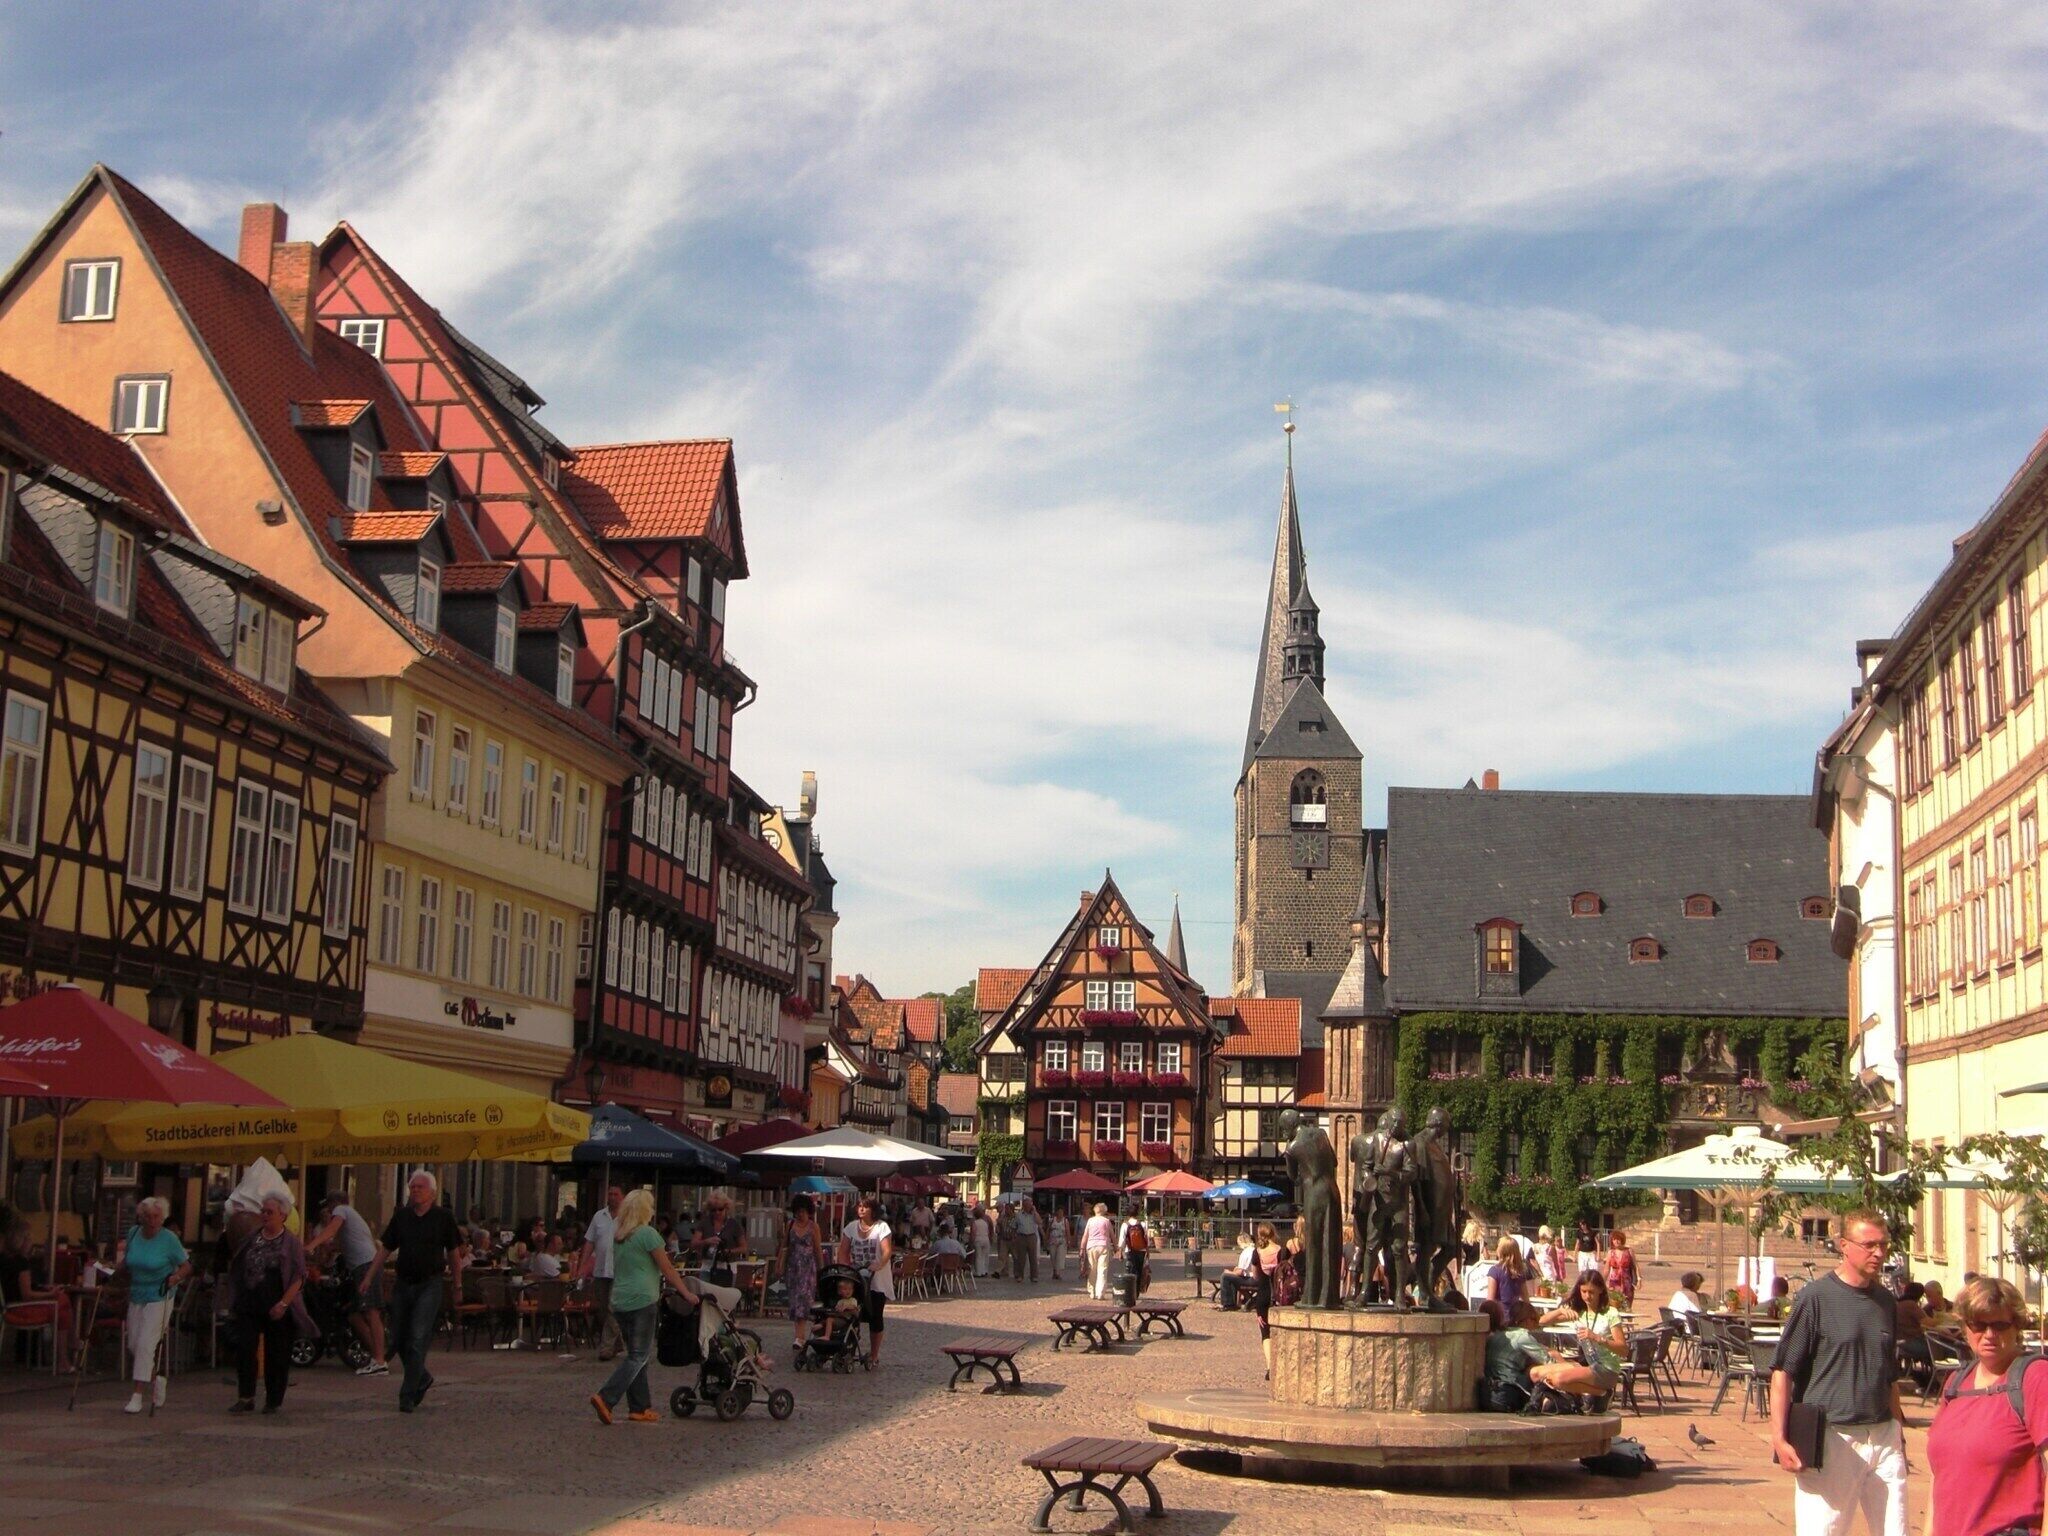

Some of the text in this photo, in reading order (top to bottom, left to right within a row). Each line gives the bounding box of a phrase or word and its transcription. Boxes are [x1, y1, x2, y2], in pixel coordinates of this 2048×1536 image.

[0, 1035, 82, 1056] häfer's
[407, 1109, 477, 1126] Erlebniscafe
[145, 1118, 298, 1142] Stadtbäckerei M.Gelbke
[606, 1150, 620, 1158] DAS
[1705, 1154, 1809, 1168] Freiberge
